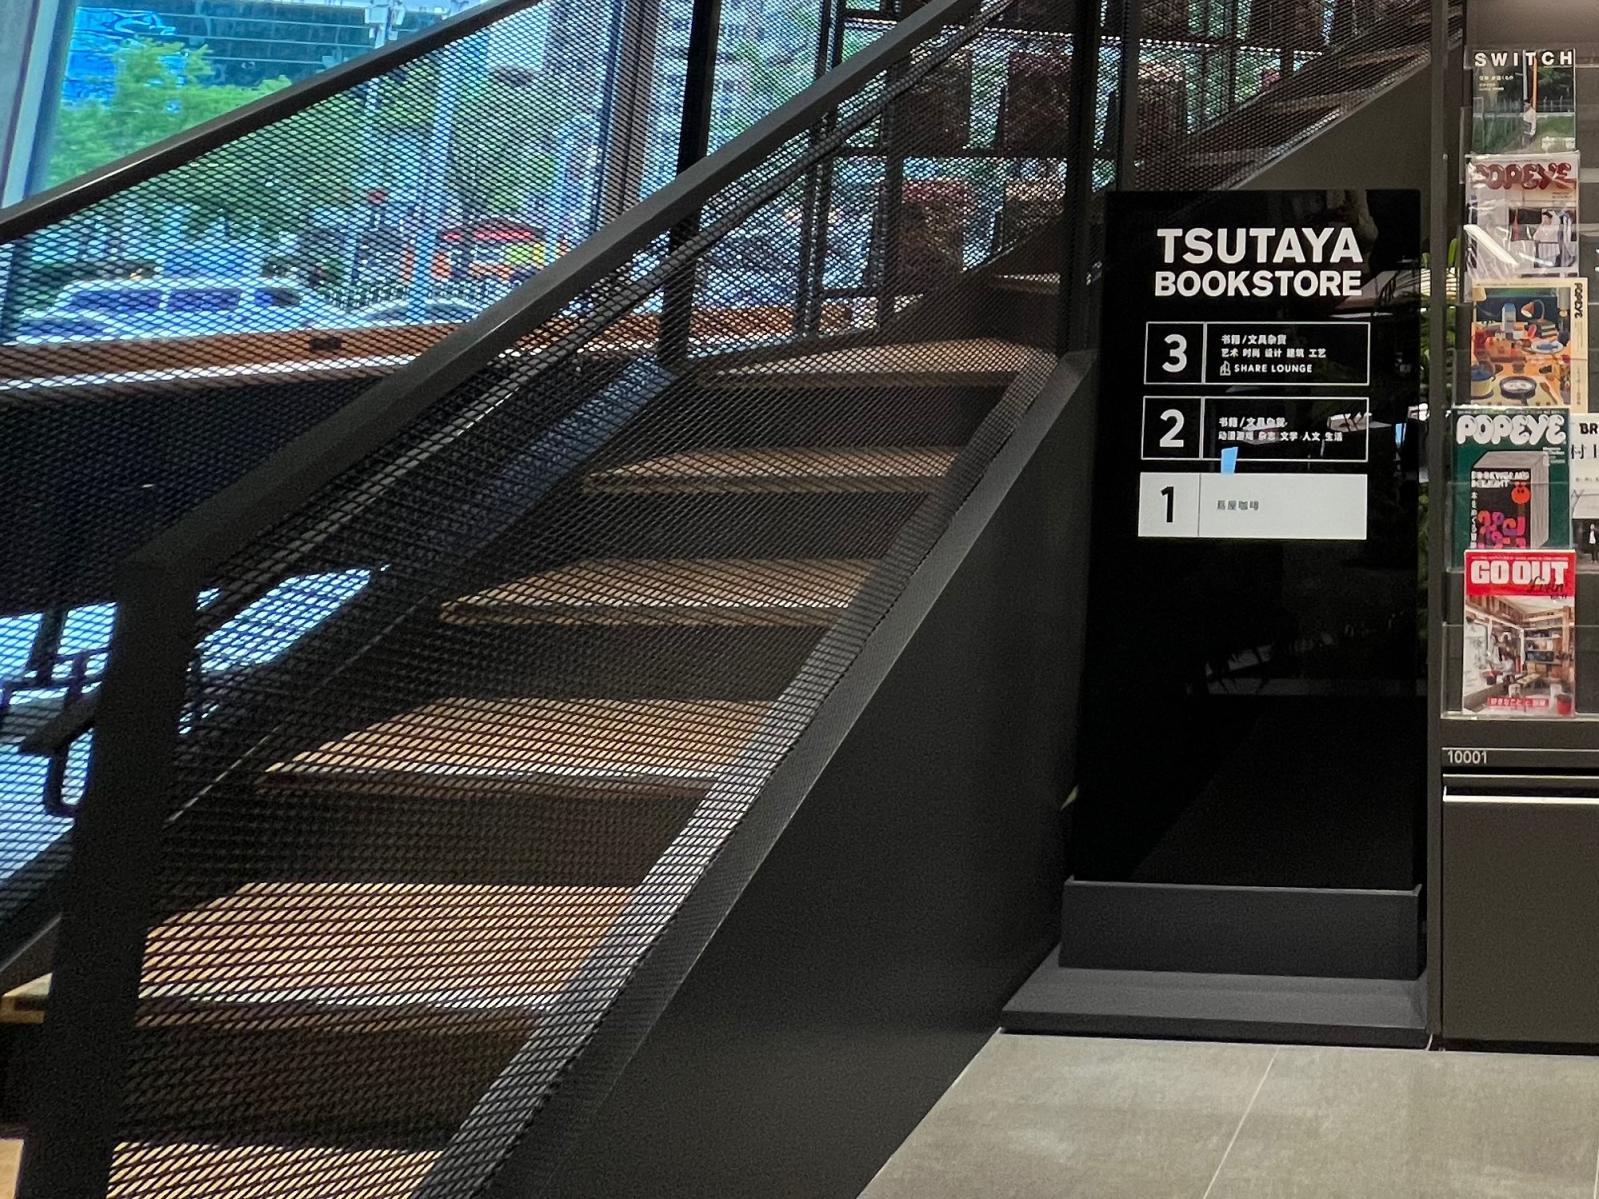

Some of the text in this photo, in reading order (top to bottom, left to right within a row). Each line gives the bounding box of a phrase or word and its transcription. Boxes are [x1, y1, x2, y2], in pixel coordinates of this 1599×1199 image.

[1475, 51, 1573, 67] SWITCH
[1156, 227, 1363, 264] TSUTAYA
[1155, 270, 1363, 297] BOOKSTORE
[1162, 334, 1187, 373] 3
[1234, 363, 1313, 373] SHARE LOUNGE
[1159, 409, 1185, 448] 2
[1302, 431, 1321, 441] 人文
[1325, 431, 1343, 441] 生活
[1456, 414, 1567, 445] POPEYE
[1160, 486, 1175, 523] 1
[1471, 560, 1569, 585] GO OUT
[1447, 750, 1488, 764] 10001
